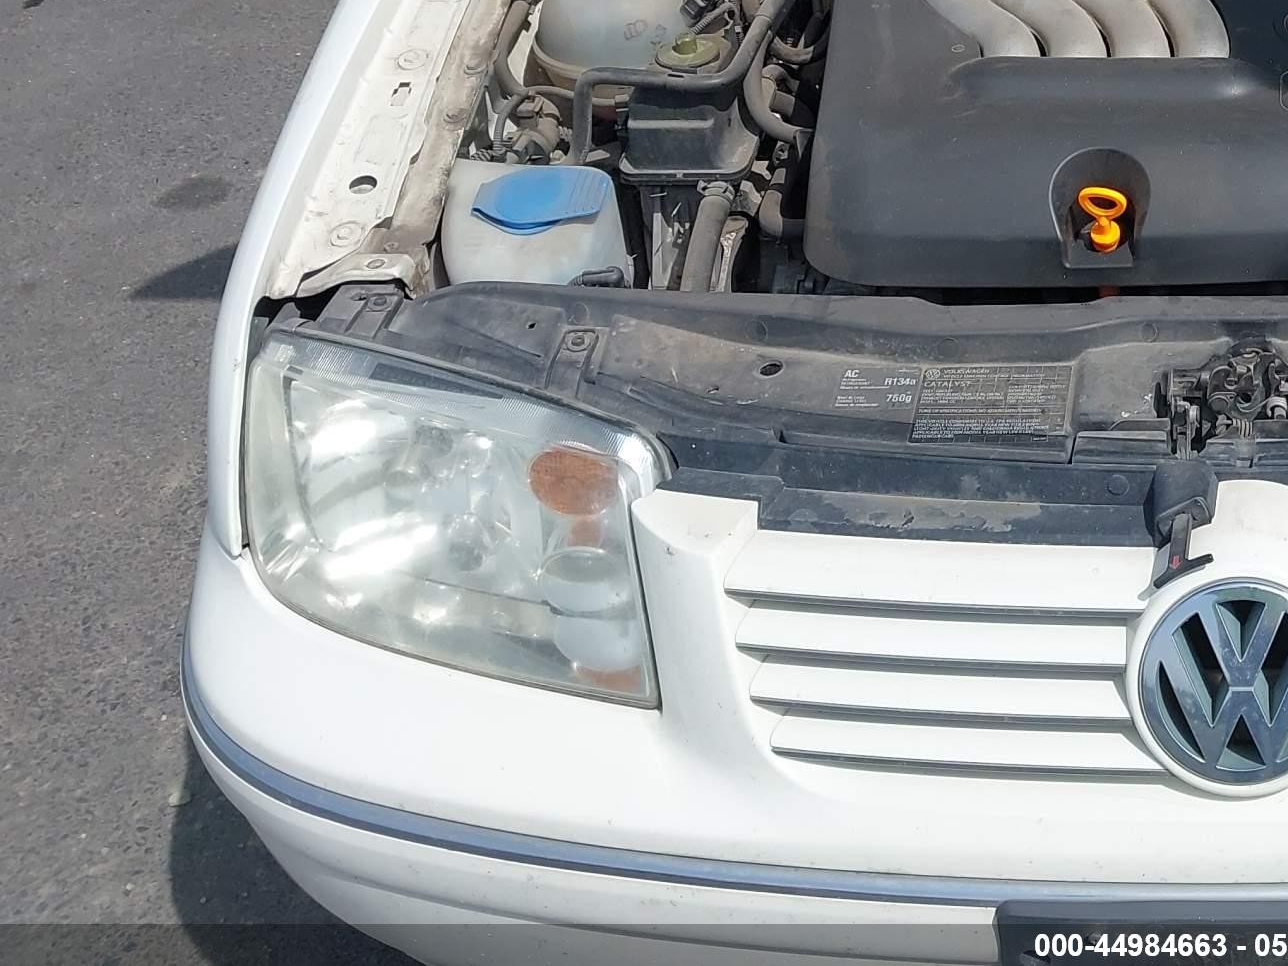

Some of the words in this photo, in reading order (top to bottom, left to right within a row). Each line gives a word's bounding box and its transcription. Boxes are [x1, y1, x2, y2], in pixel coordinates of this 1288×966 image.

[844, 369, 860, 378] AC
[884, 377, 917, 386] R134a
[924, 380, 971, 388] CATALYST
[886, 393, 912, 403] 750g
